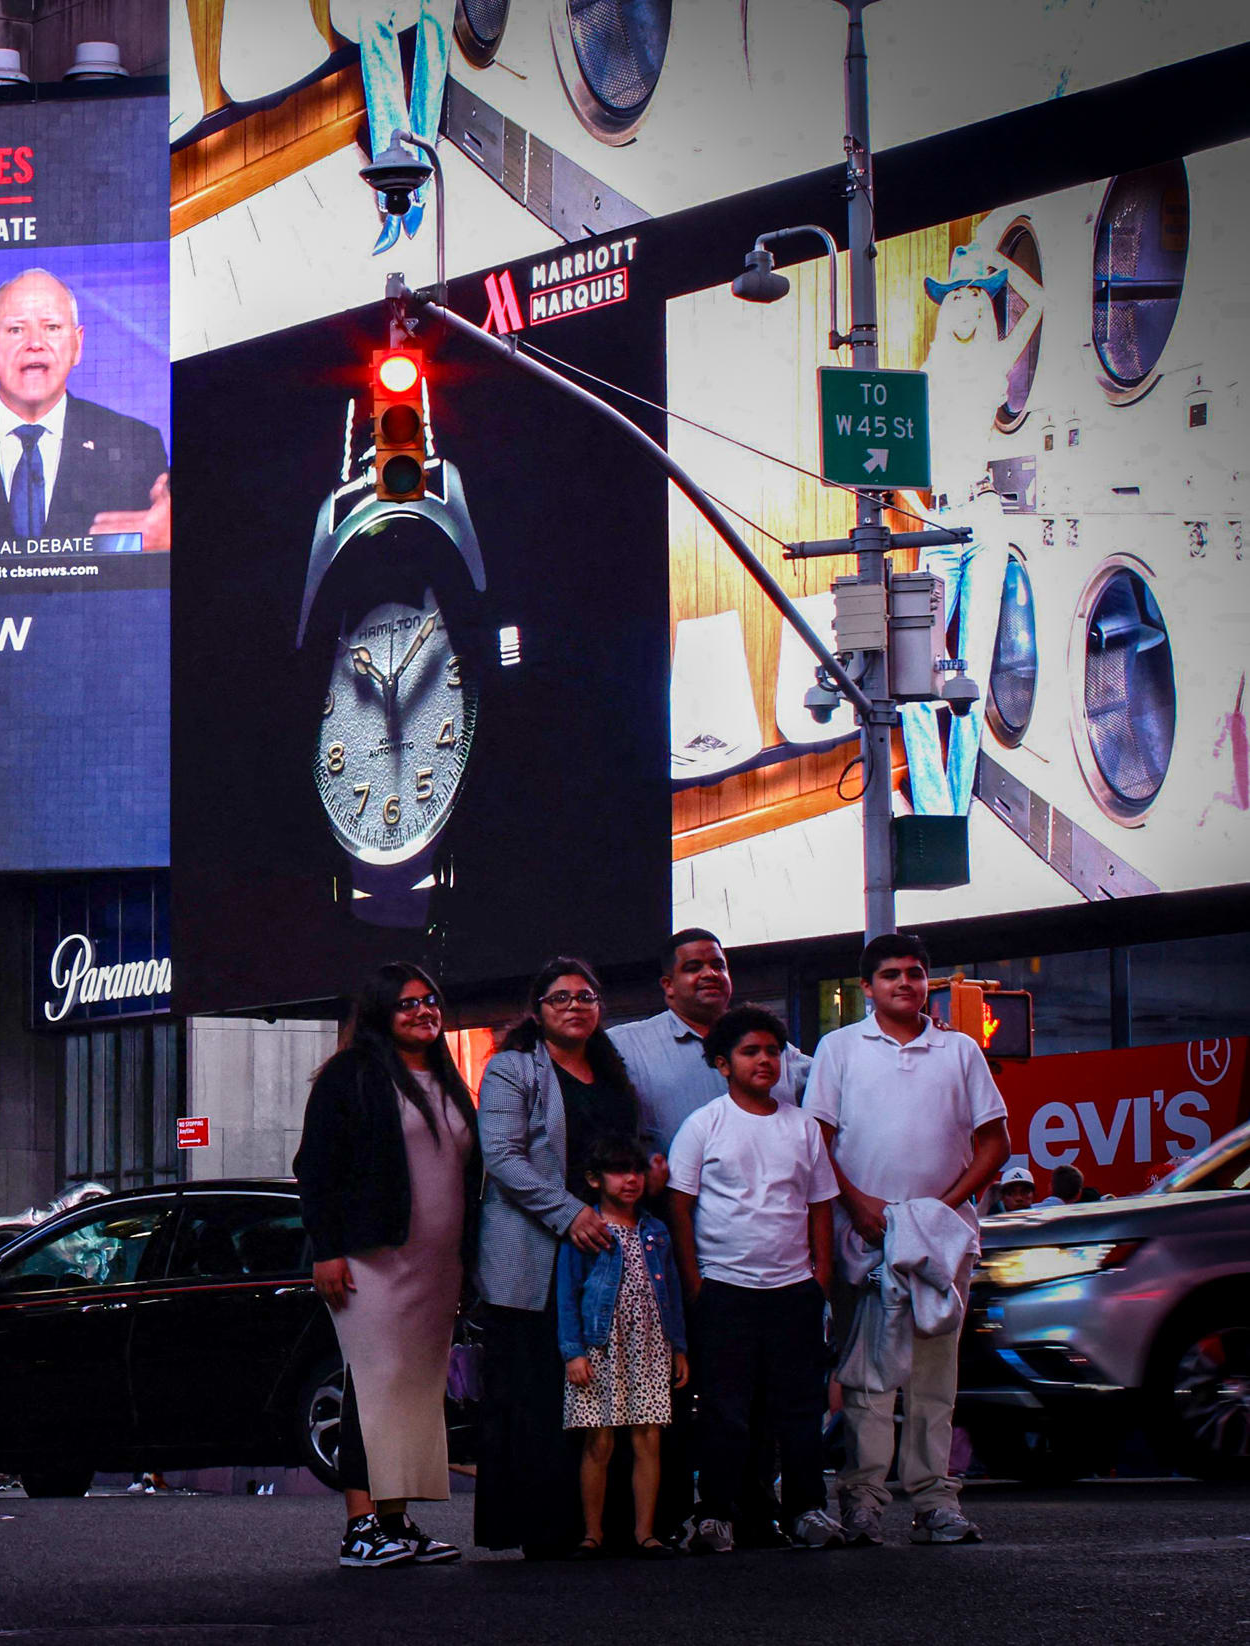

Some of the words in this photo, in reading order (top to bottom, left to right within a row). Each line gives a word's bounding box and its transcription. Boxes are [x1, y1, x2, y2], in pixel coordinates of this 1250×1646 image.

[532, 237, 637, 289] MARRIOTT
[533, 274, 624, 320] MARQUIS
[860, 383, 887, 405] TO
[836, 414, 852, 436] W
[857, 416, 887, 437] 45
[893, 417, 914, 439] St
[28, 537, 94, 553] DEBATE
[10, 565, 98, 578] cbsnews.com
[359, 615, 421, 640] HAMILTON
[938, 660, 966, 671] NYPD
[437, 717, 456, 748] 4
[327, 742, 345, 773] 8
[416, 768, 434, 800] 5
[354, 783, 370, 817] 7
[383, 794, 401, 825] 6
